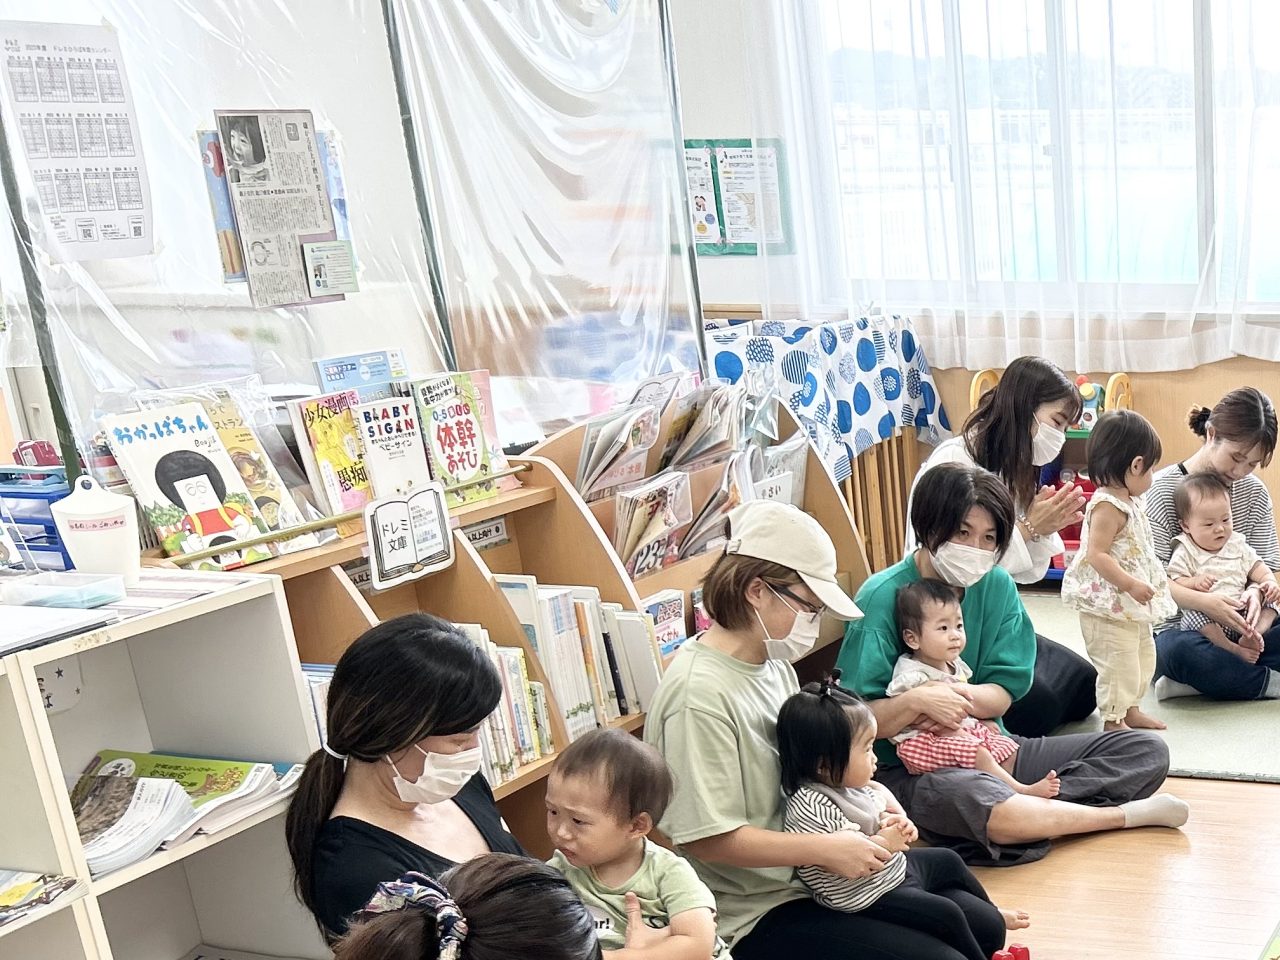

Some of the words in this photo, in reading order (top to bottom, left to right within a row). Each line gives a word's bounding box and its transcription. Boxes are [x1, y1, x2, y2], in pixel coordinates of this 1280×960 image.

[363, 404, 410, 423] BABY
[367, 418, 415, 438] SIGN
[436, 418, 477, 454] 体幹
[380, 440, 412, 451] ベビーサイン
[446, 448, 478, 475] あそび
[381, 519, 409, 538] ドレミ
[387, 535, 408, 554] 文庫
